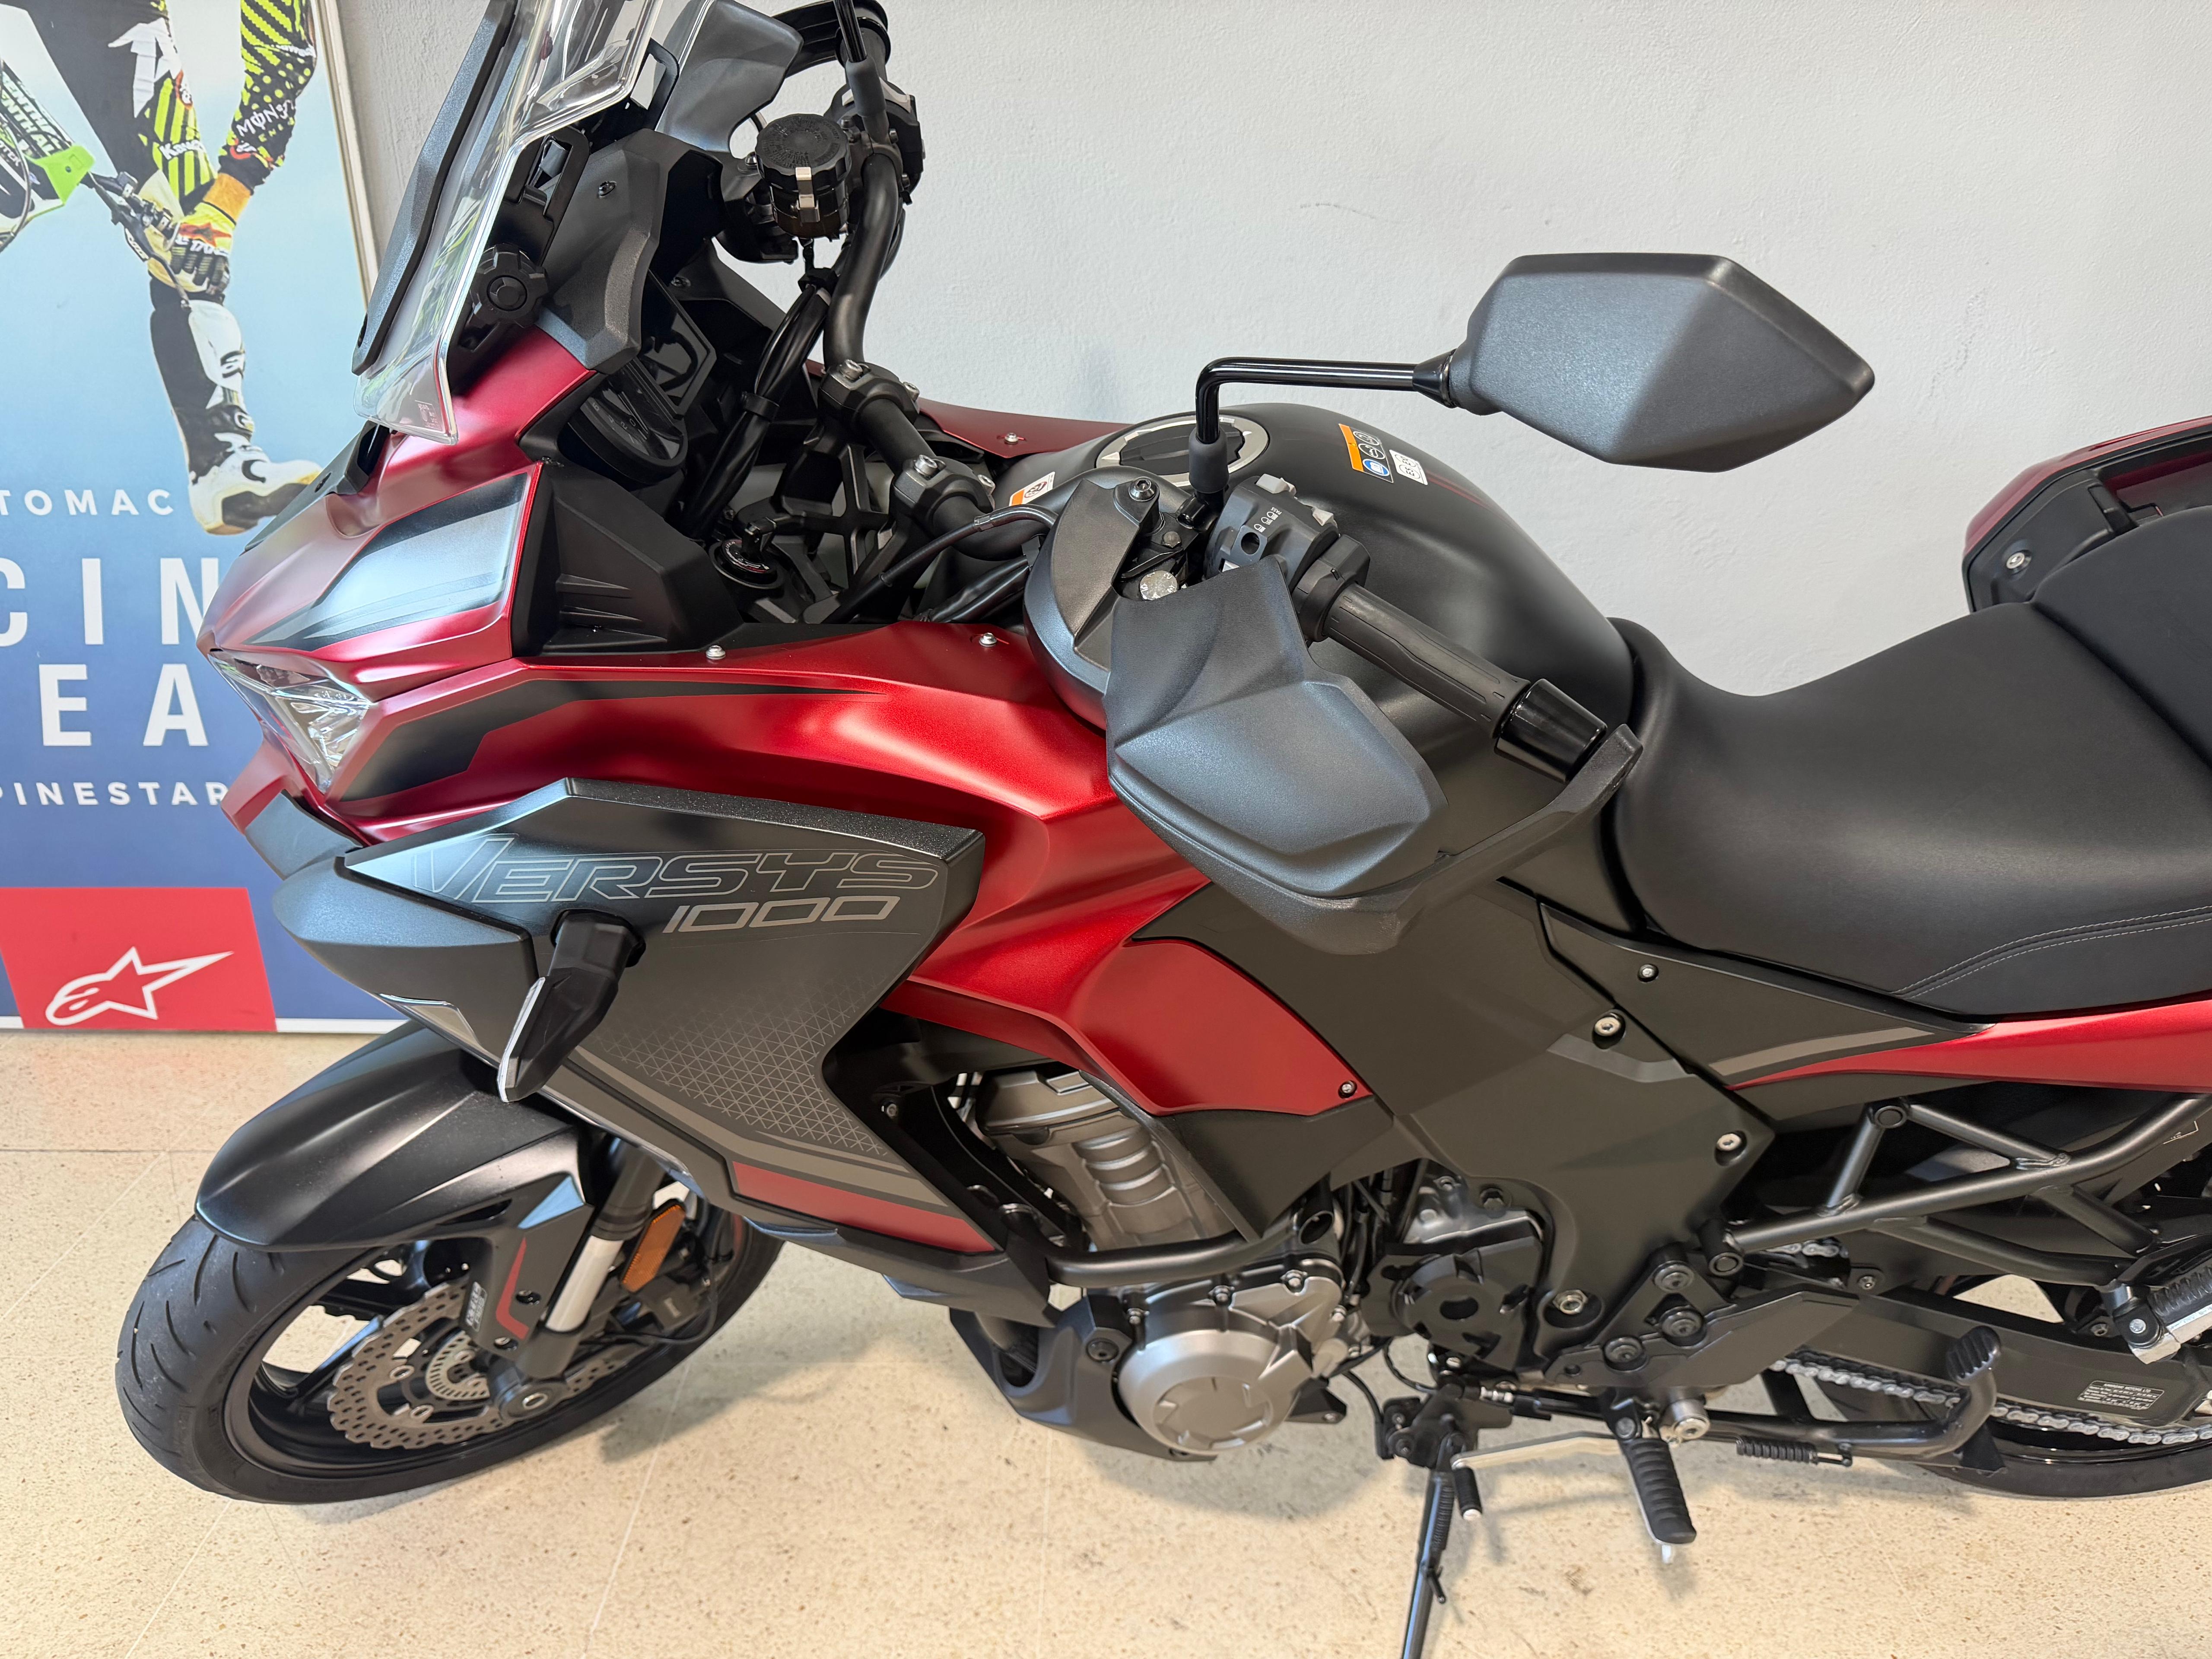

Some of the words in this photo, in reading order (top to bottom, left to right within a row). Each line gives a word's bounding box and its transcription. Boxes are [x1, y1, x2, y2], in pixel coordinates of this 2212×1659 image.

[0, 489, 174, 515] TOMAC
[1271, 507, 1282, 515] PASS
[39, 664, 209, 746] EA
[0, 782, 228, 805] INESTAR
[414, 837, 938, 903] VERSYS
[662, 896, 900, 933] 1000
